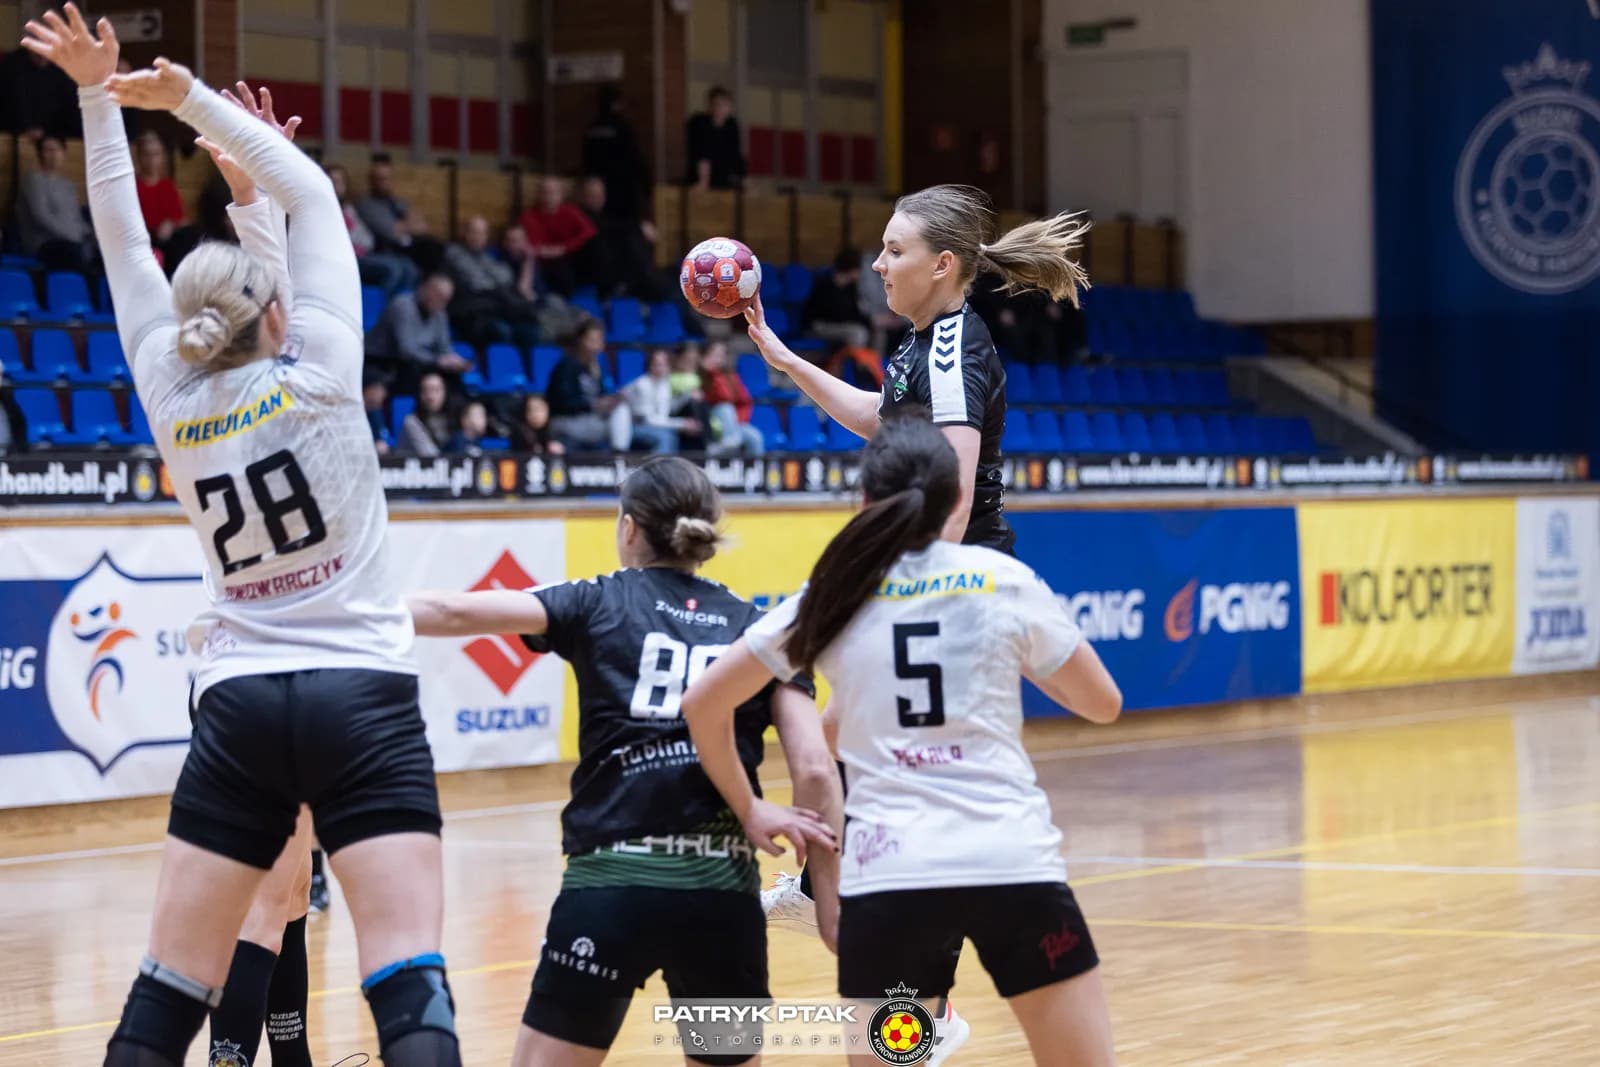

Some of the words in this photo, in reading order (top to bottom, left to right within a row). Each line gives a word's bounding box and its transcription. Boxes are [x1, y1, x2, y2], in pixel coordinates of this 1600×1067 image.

[194, 449, 327, 576] 28
[655, 600, 728, 627] ZWIEGER
[1338, 562, 1492, 625] KOLPORTER
[893, 621, 945, 728] 5
[456, 705, 550, 733] SUZUKI
[548, 949, 619, 981] INSIGNIS
